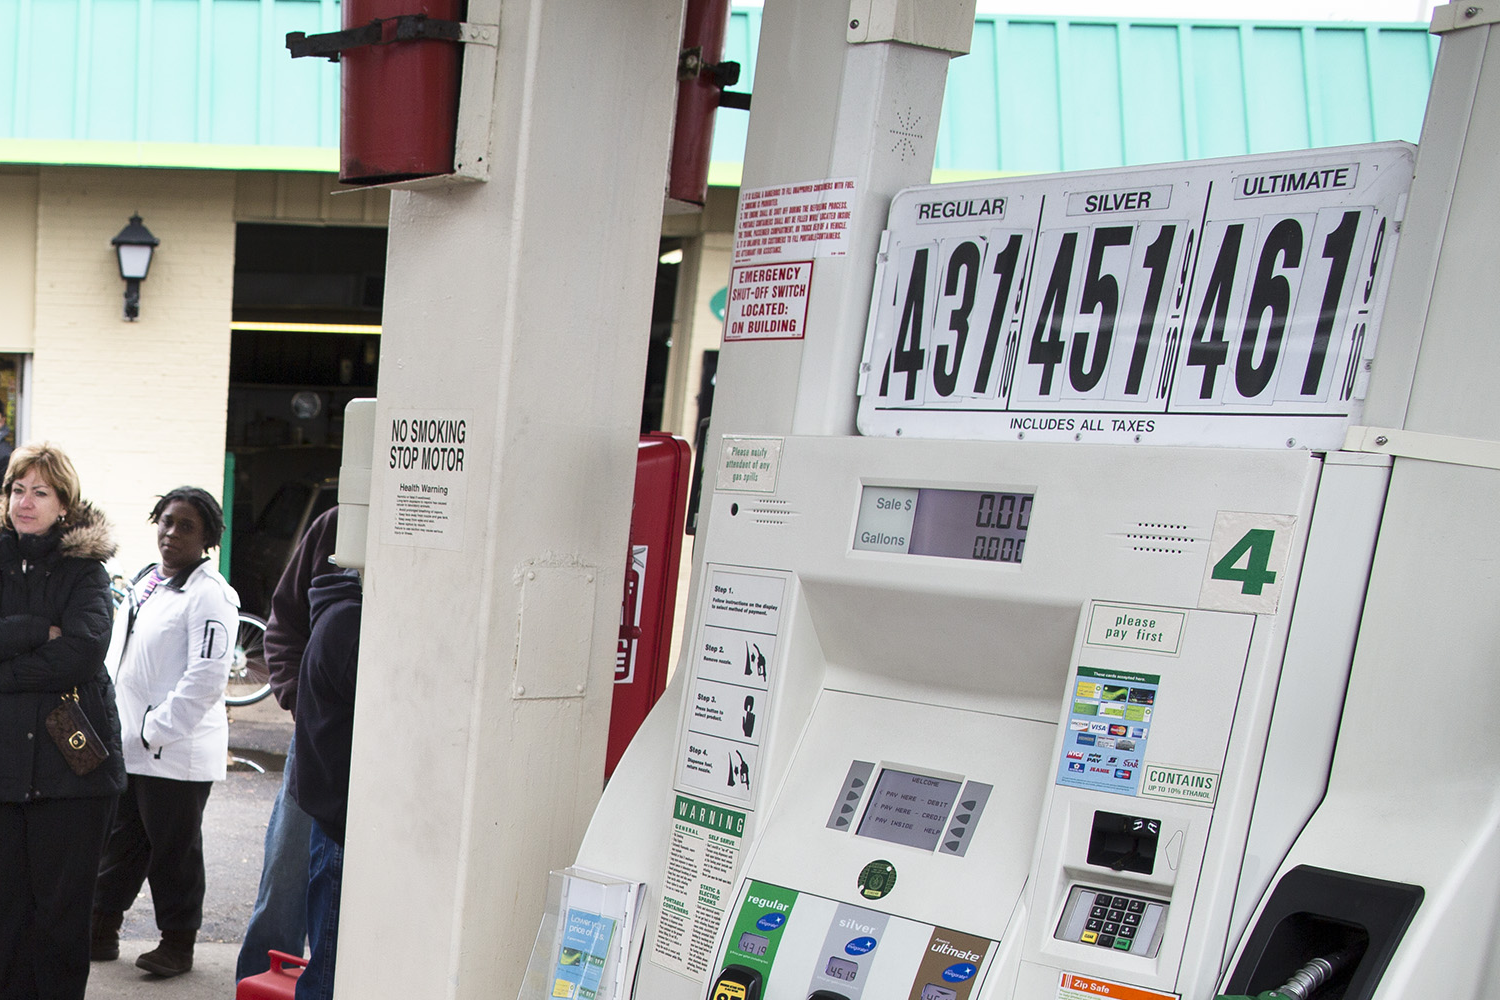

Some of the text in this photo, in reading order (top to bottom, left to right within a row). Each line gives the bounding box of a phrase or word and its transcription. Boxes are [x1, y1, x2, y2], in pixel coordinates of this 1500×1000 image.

[1242, 168, 1349, 197] ULTIMATE
[918, 198, 1005, 220] REGULAR
[1084, 191, 1152, 214] SILVER
[739, 267, 801, 284] EMERGENCY
[732, 284, 806, 301] SHUT-OFF SWITCH
[741, 302, 788, 317] LOCATED:
[1028, 225, 1177, 396] 451
[1187, 210, 1362, 400] 461
[894, 234, 1023, 401] 431
[731, 319, 797, 334] ON BUILDING
[391, 419, 466, 444] NO SMOKING
[1009, 418, 1155, 433] INCLUDES ALL TAXES
[389, 446, 465, 472] STOP MOTOR
[732, 446, 768, 458] Please notify
[726, 460, 770, 472] attendant of any
[732, 472, 758, 483] gas spills
[400, 483, 448, 496] Health Warning
[876, 497, 912, 512] Sale $
[976, 494, 1034, 530] 0.00
[861, 532, 905, 546] Gallons
[1211, 529, 1277, 596] 4
[714, 585, 728, 594] Step
[725, 599, 748, 607] instructions
[762, 603, 778, 612] display
[1115, 614, 1156, 628] please
[1106, 627, 1163, 642] pay first
[704, 644, 724, 654] Step 2.
[704, 656, 718, 664] Remove
[697, 693, 716, 704] Step 3.
[1091, 724, 1106, 732] VISA
[688, 746, 702, 756] Step
[1122, 759, 1139, 768] STAR
[911, 776, 940, 788] WELCOME
[1150, 769, 1213, 790] CONTAINS
[886, 790, 948, 808] PAY HERE DEBIT
[1148, 784, 1210, 799] UP TO 10% ETHANOL
[678, 801, 744, 833] WARNING
[880, 804, 947, 822] PAY HERE CREDIT
[674, 824, 699, 836] GENERAL
[874, 816, 941, 836] PAY INSIDE HELP
[708, 834, 735, 846] SELF SERVE
[698, 890, 720, 902] ELECTRIC
[700, 884, 716, 894] STATIC
[664, 896, 684, 908] PORTABLE
[698, 896, 716, 906] SPARKS
[748, 896, 789, 912] regular
[662, 902, 689, 916] CONTAINERS
[569, 925, 586, 936] price
[839, 918, 876, 934] silver
[930, 943, 980, 962] ultimate
[1073, 979, 1110, 994] Zip Safe
